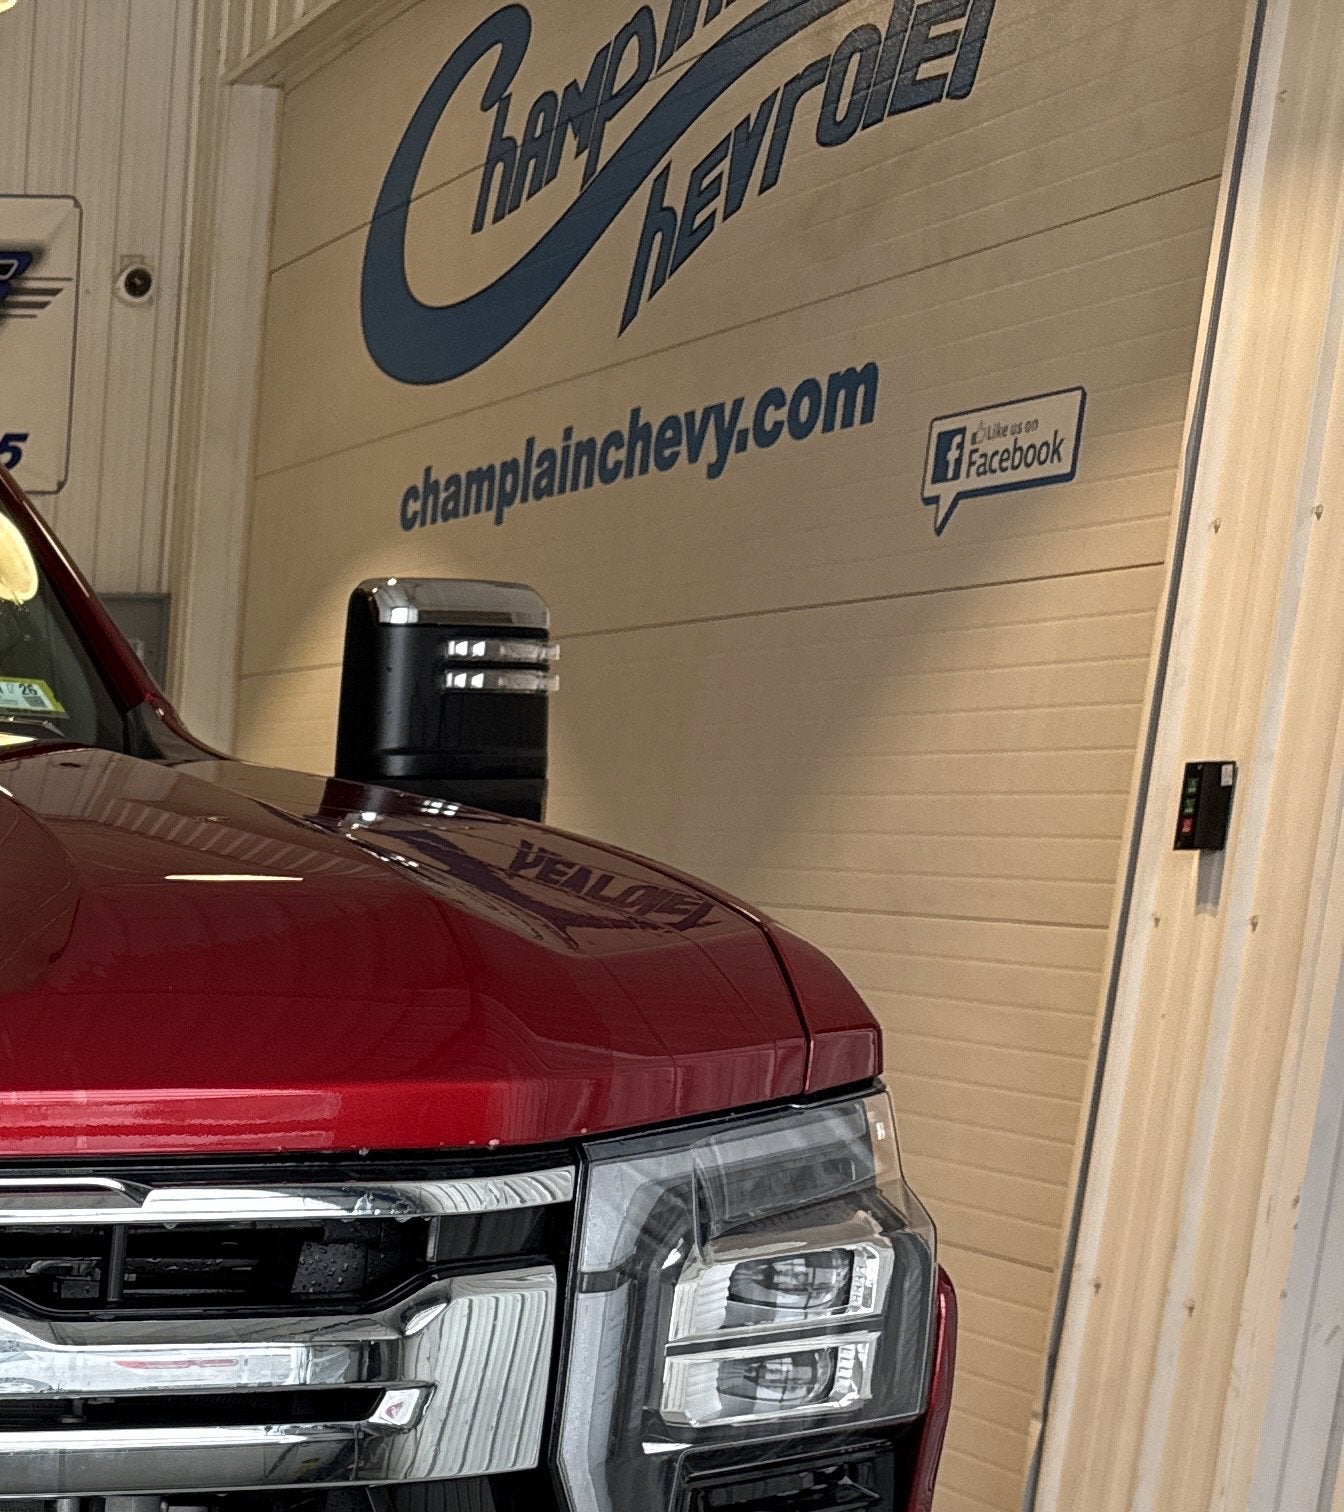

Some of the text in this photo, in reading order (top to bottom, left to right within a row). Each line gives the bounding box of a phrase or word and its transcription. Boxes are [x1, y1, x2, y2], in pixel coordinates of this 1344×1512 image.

[399, 361, 879, 531] champlainchevy.com
[966, 429, 1066, 479] Facebook
[987, 417, 1040, 441] Like us on
